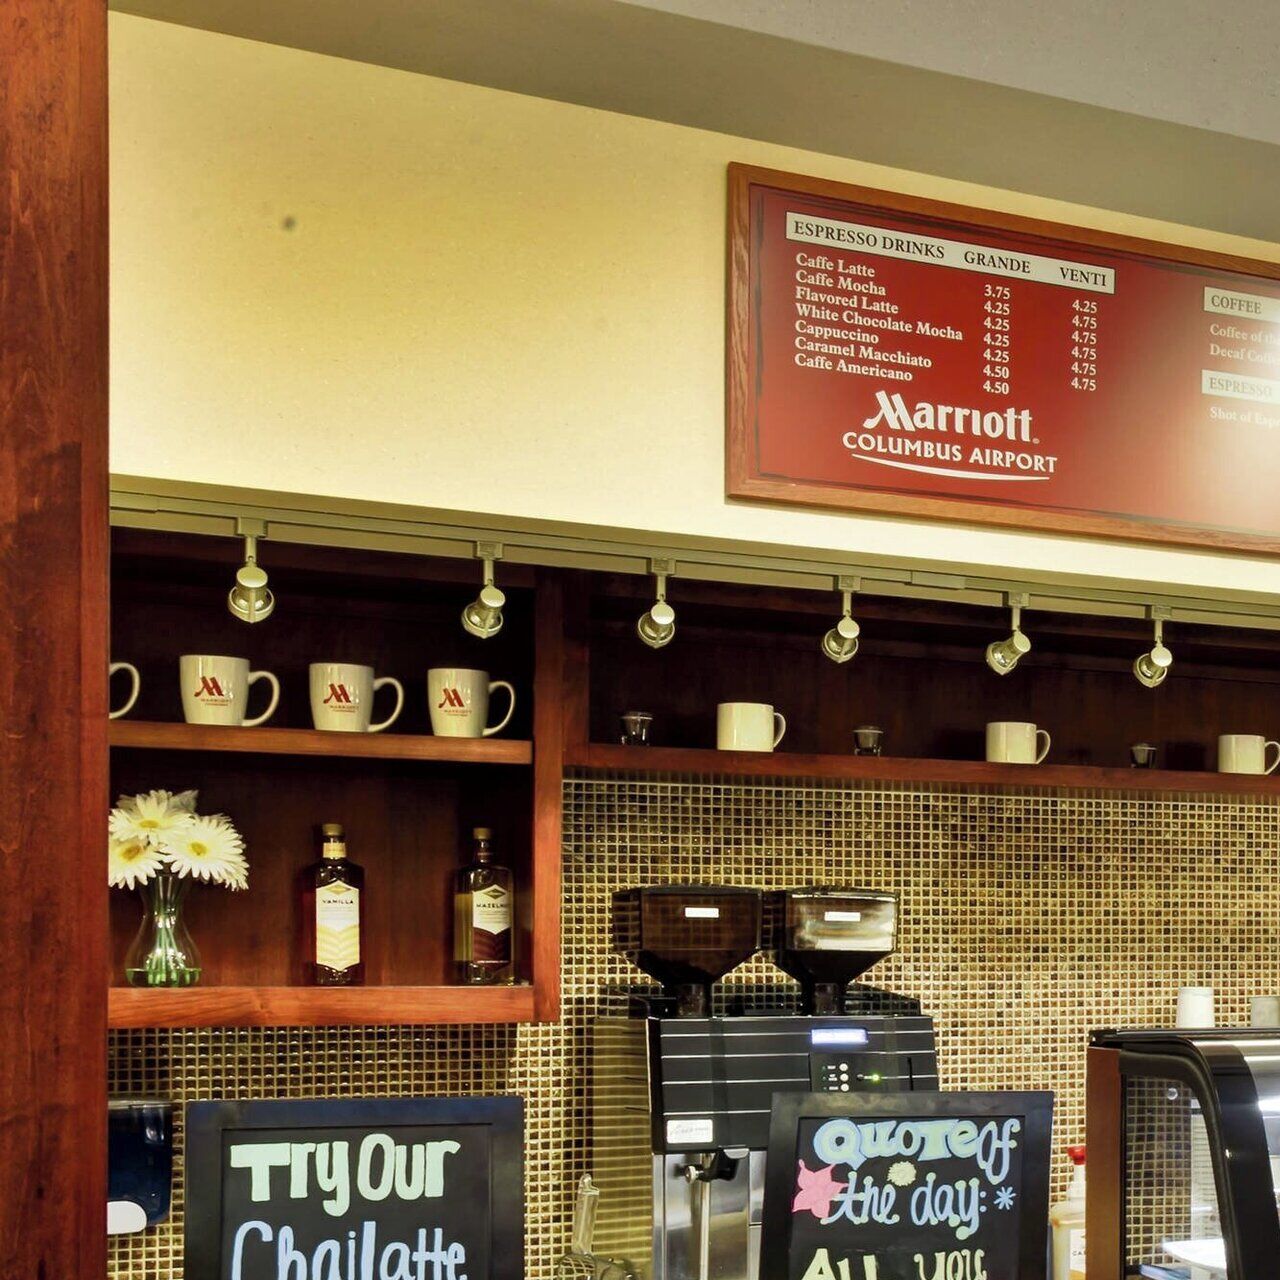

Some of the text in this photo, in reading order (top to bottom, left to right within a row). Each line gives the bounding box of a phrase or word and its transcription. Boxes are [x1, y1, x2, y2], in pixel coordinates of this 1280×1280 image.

[794, 220, 1107, 287] ESPRESSO DRINKS GRANDE VENTI
[796, 253, 1098, 314] Caffe Latte 3.75 4.25
[796, 270, 1097, 329] Caffe Mocha 4.25 4.75
[1211, 294, 1262, 314] COFFEE
[796, 286, 1097, 345] Flavored Latte 4.25 4.75
[796, 303, 1097, 360] White Chocolate Mocha 4.25 4.75
[1210, 324, 1248, 342] Coffee
[795, 319, 1096, 376] Cappuccino 4.25 4.75
[795, 337, 1096, 391] Caramel Macchiato 4.50 4.75
[795, 353, 1009, 395] Caffe Americano 4.50
[1210, 343, 1246, 360] Decaf
[1209, 377, 1272, 397] ESPRESSO
[1210, 406, 1238, 422] Shot
[863, 390, 1033, 443] Marriott
[842, 432, 1057, 474] COLUMBUS AIRPORT
[230, 1133, 461, 1217] Try Our
[820, 1171, 899, 1225] the
